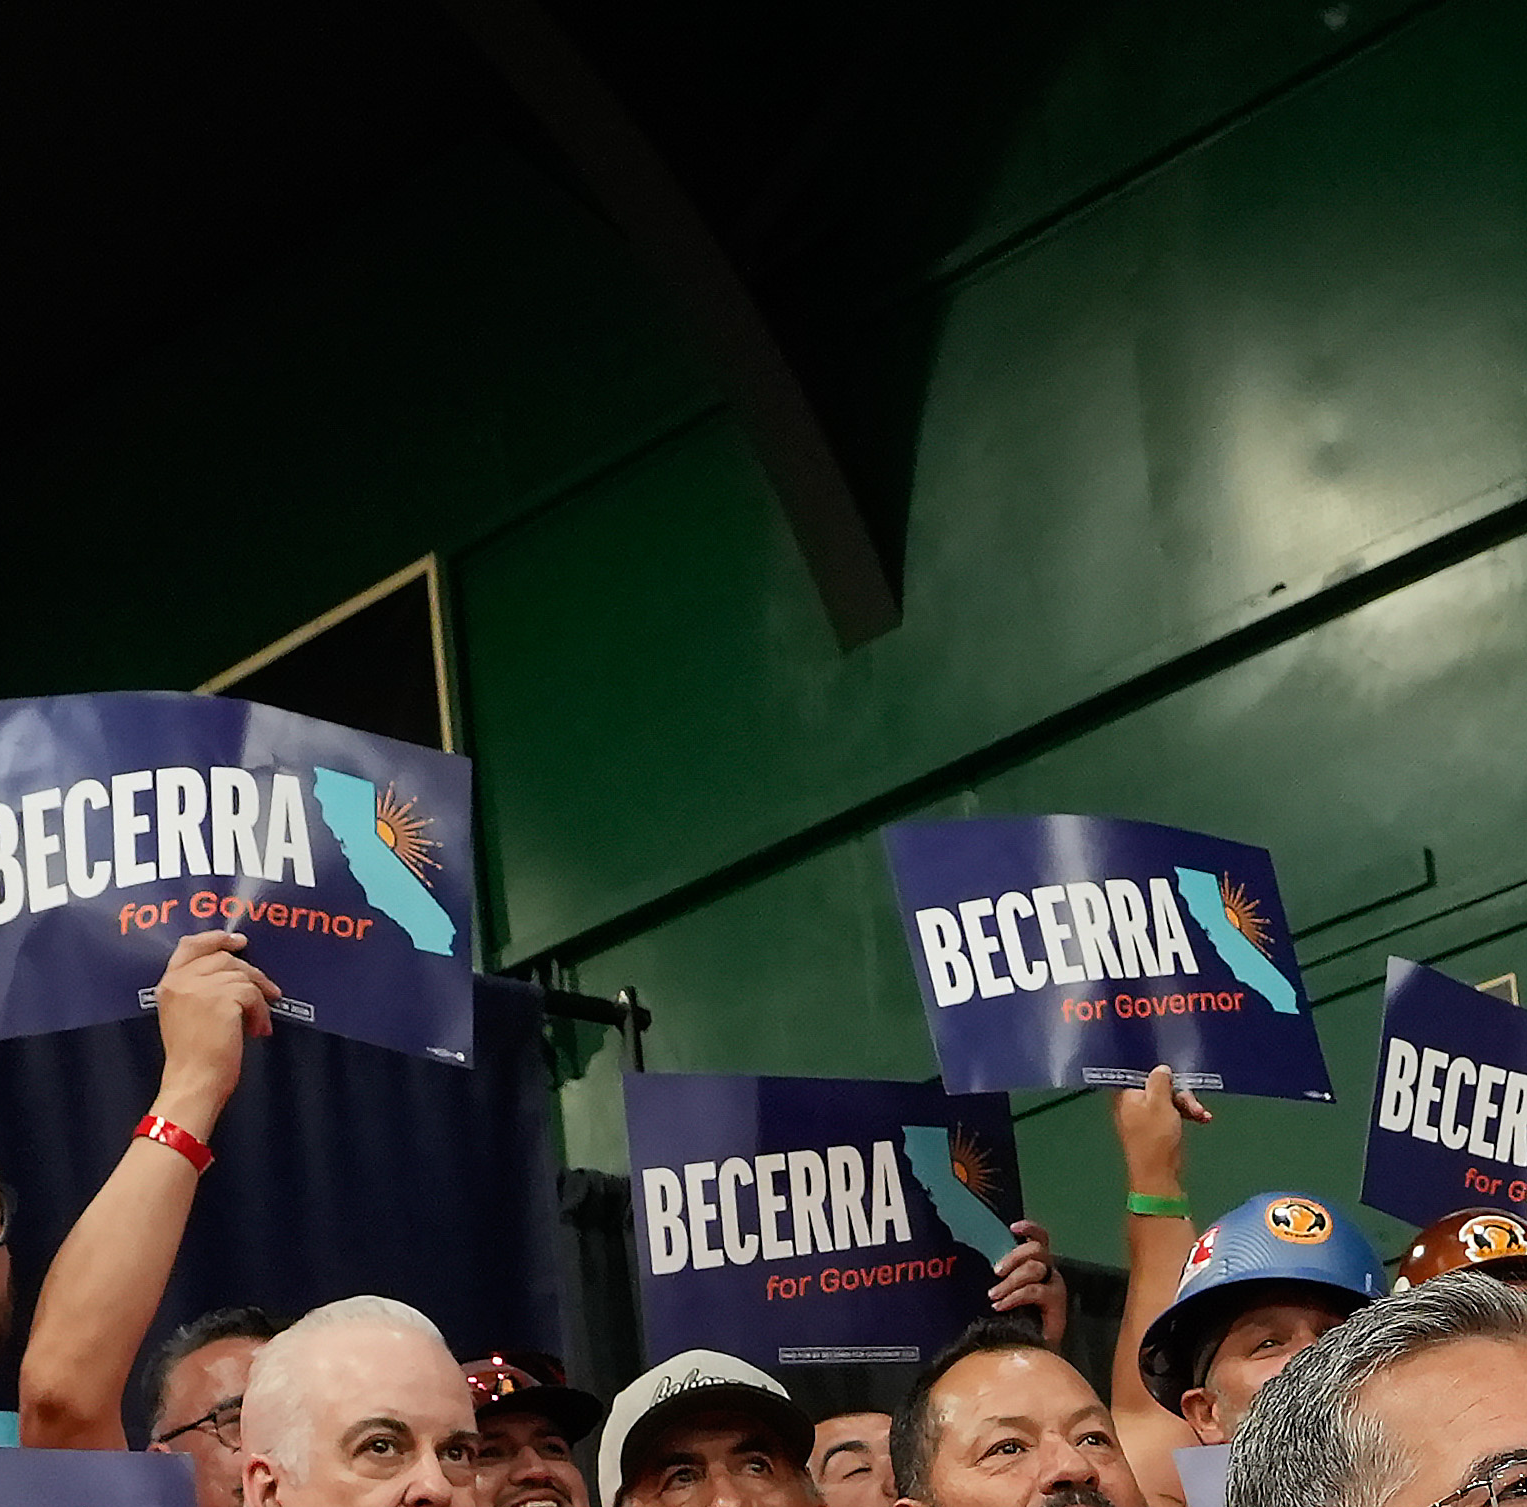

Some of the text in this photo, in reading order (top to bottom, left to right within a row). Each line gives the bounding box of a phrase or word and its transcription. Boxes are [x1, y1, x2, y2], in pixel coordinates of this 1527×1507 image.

[121, 891, 373, 940] for Governor
[916, 878, 1198, 1008] BECERRA
[1062, 988, 1244, 1023] for Governor
[1464, 1168, 1503, 1197] for
[643, 1141, 911, 1274] BECERRA
[766, 1254, 956, 1302] for Governor
